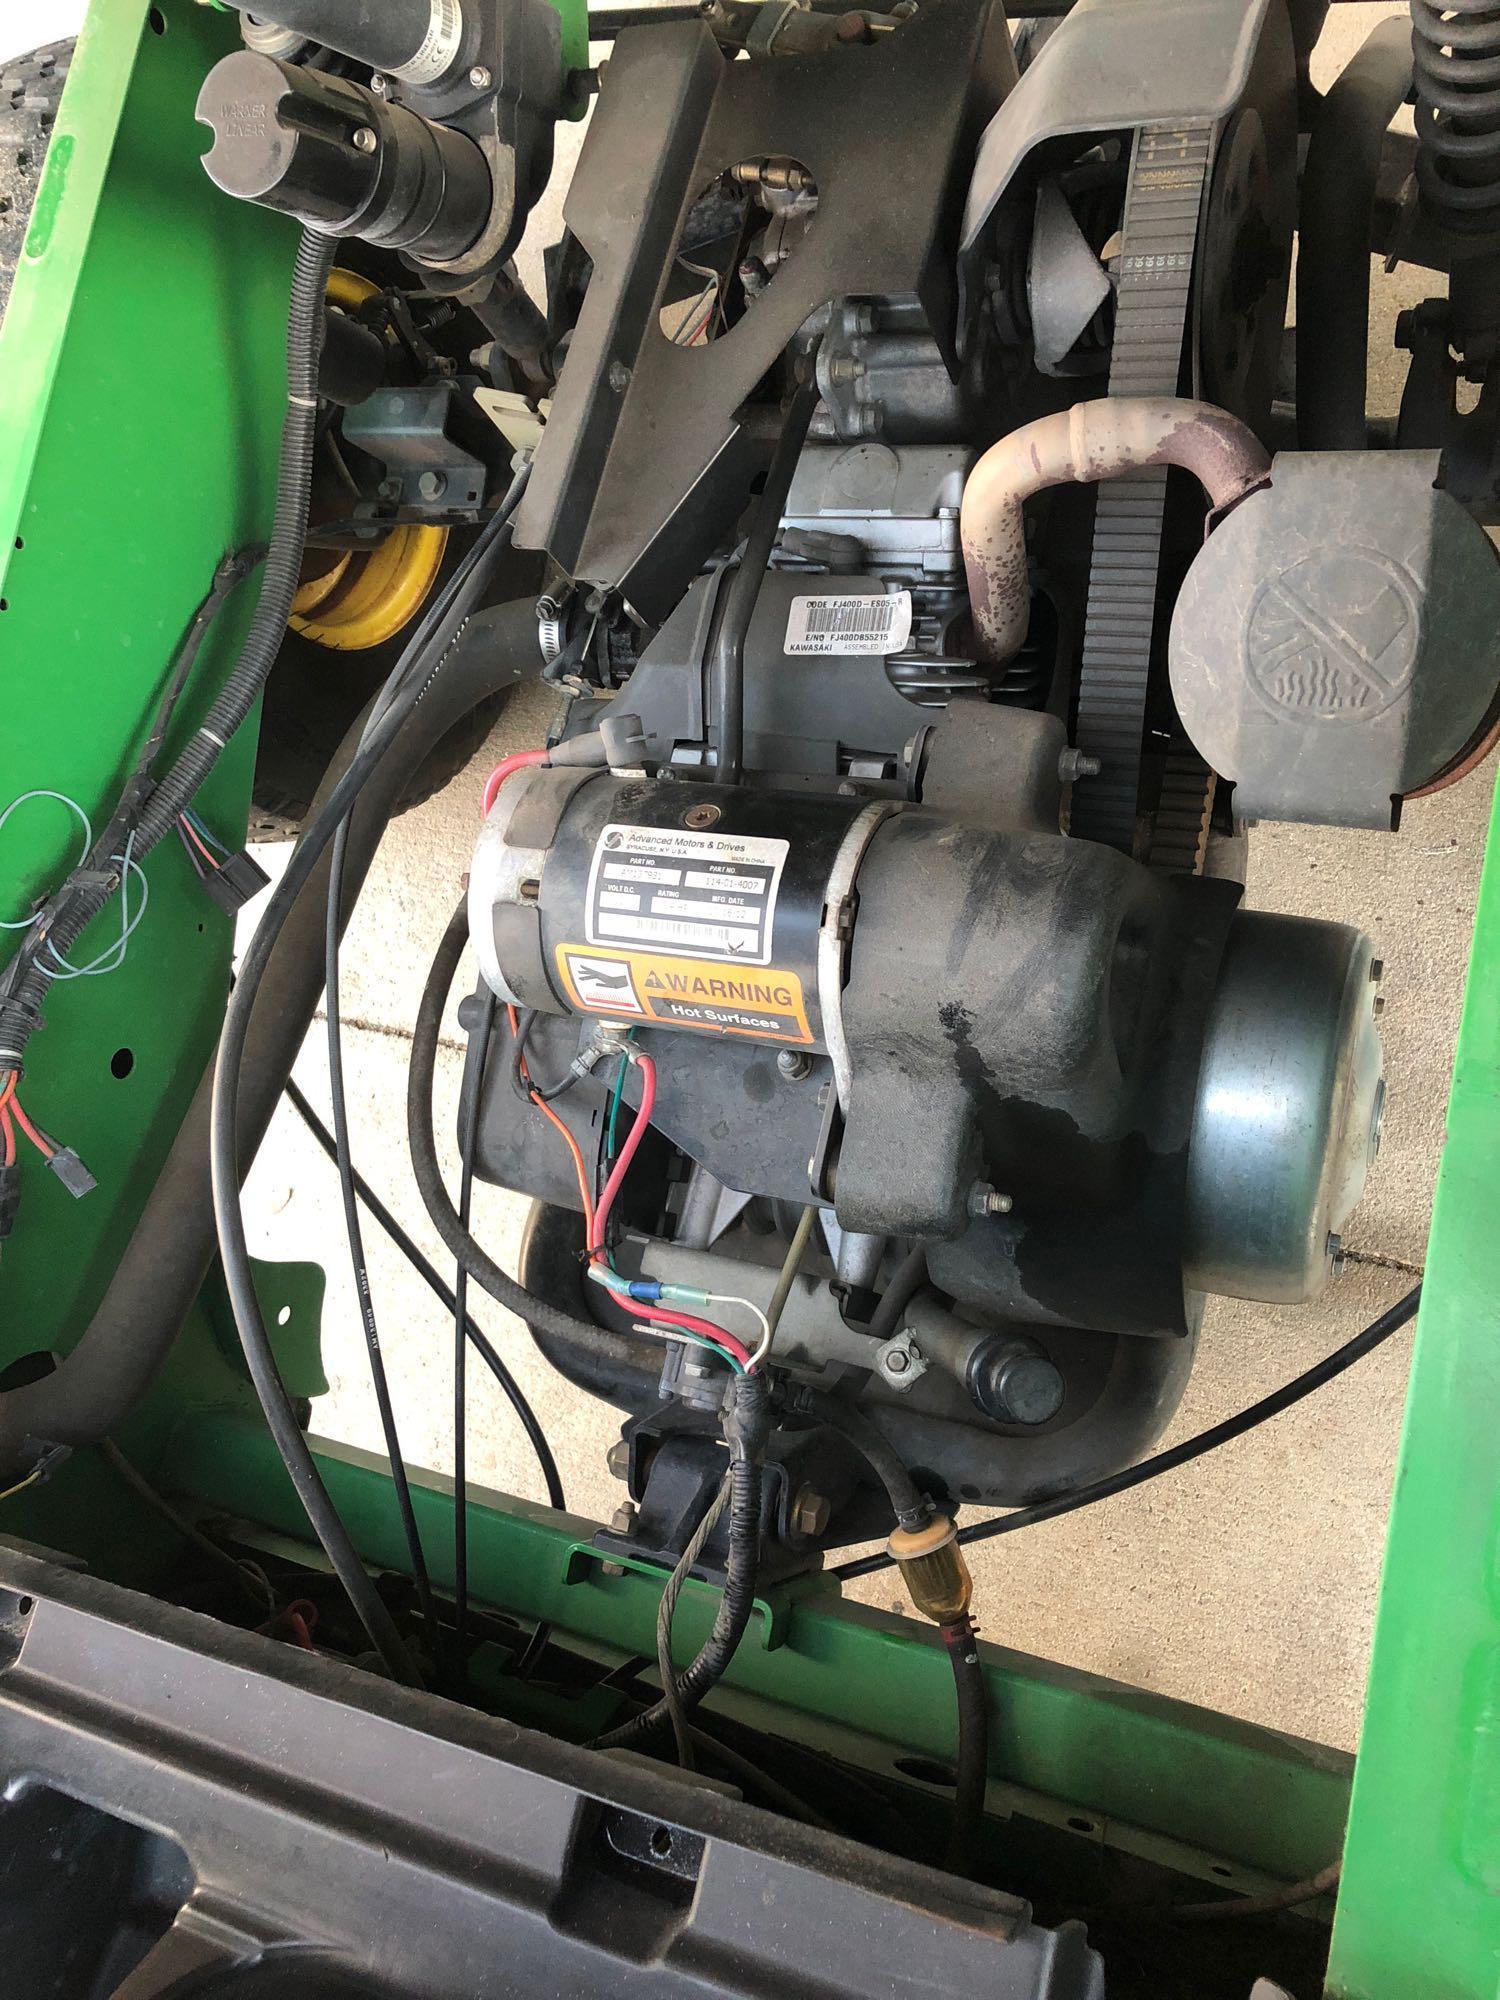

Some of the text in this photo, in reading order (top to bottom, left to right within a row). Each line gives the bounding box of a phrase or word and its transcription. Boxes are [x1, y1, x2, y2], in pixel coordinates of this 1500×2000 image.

[220, 103, 266, 119] WARNER
[226, 123, 265, 137] LINEAR
[806, 601, 828, 609] CODE
[789, 643, 833, 652] KAWASAKI
[628, 833, 746, 853] Advanced Motors & Drives
[629, 857, 656, 866] PART NO.
[709, 865, 736, 875] PART NO.
[607, 884, 623, 893] VOLT
[705, 877, 759, 891] 114-01-4007
[657, 889, 680, 899] RATING
[728, 897, 745, 906] DATE
[665, 972, 793, 1007] WARNING
[670, 1003, 781, 1031] Hot Surfaces
